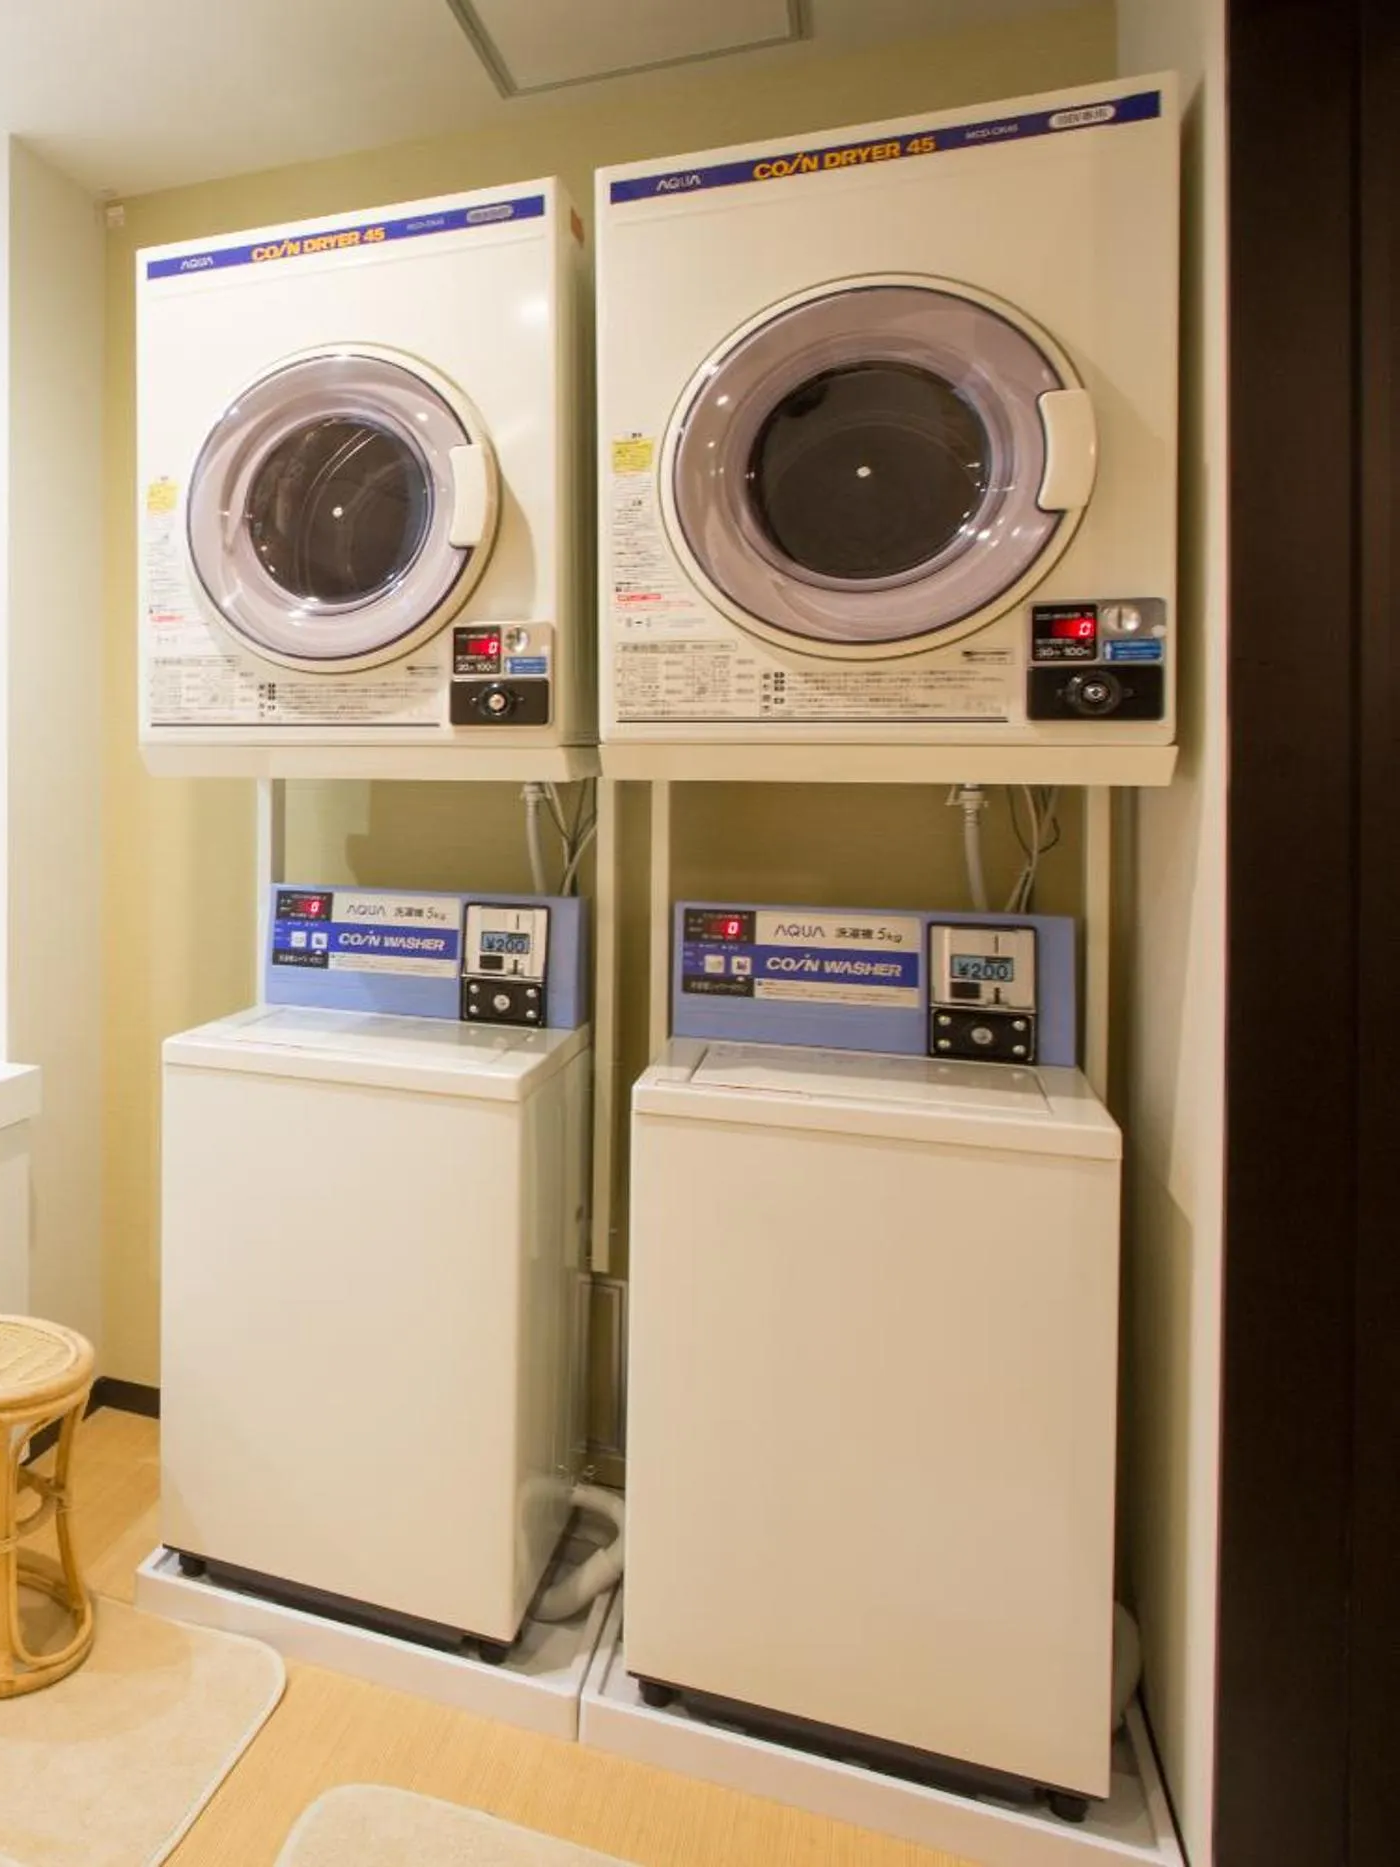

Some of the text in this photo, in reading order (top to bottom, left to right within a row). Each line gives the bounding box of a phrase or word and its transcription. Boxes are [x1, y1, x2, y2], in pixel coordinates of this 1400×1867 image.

[655, 174, 701, 192] AQUA
[823, 140, 901, 169] DRYER
[906, 136, 936, 154] 45
[180, 256, 214, 271] AQUA
[303, 230, 360, 254] DRYER
[363, 227, 386, 242] 45
[1079, 621, 1091, 636] 0
[488, 641, 498, 654] 0
[346, 904, 387, 917] AQUA
[727, 921, 739, 935] 0
[774, 924, 826, 940] AQUA
[877, 928, 903, 944] 5kg
[383, 936, 446, 951] WASHER
[823, 960, 903, 977] WASHER
